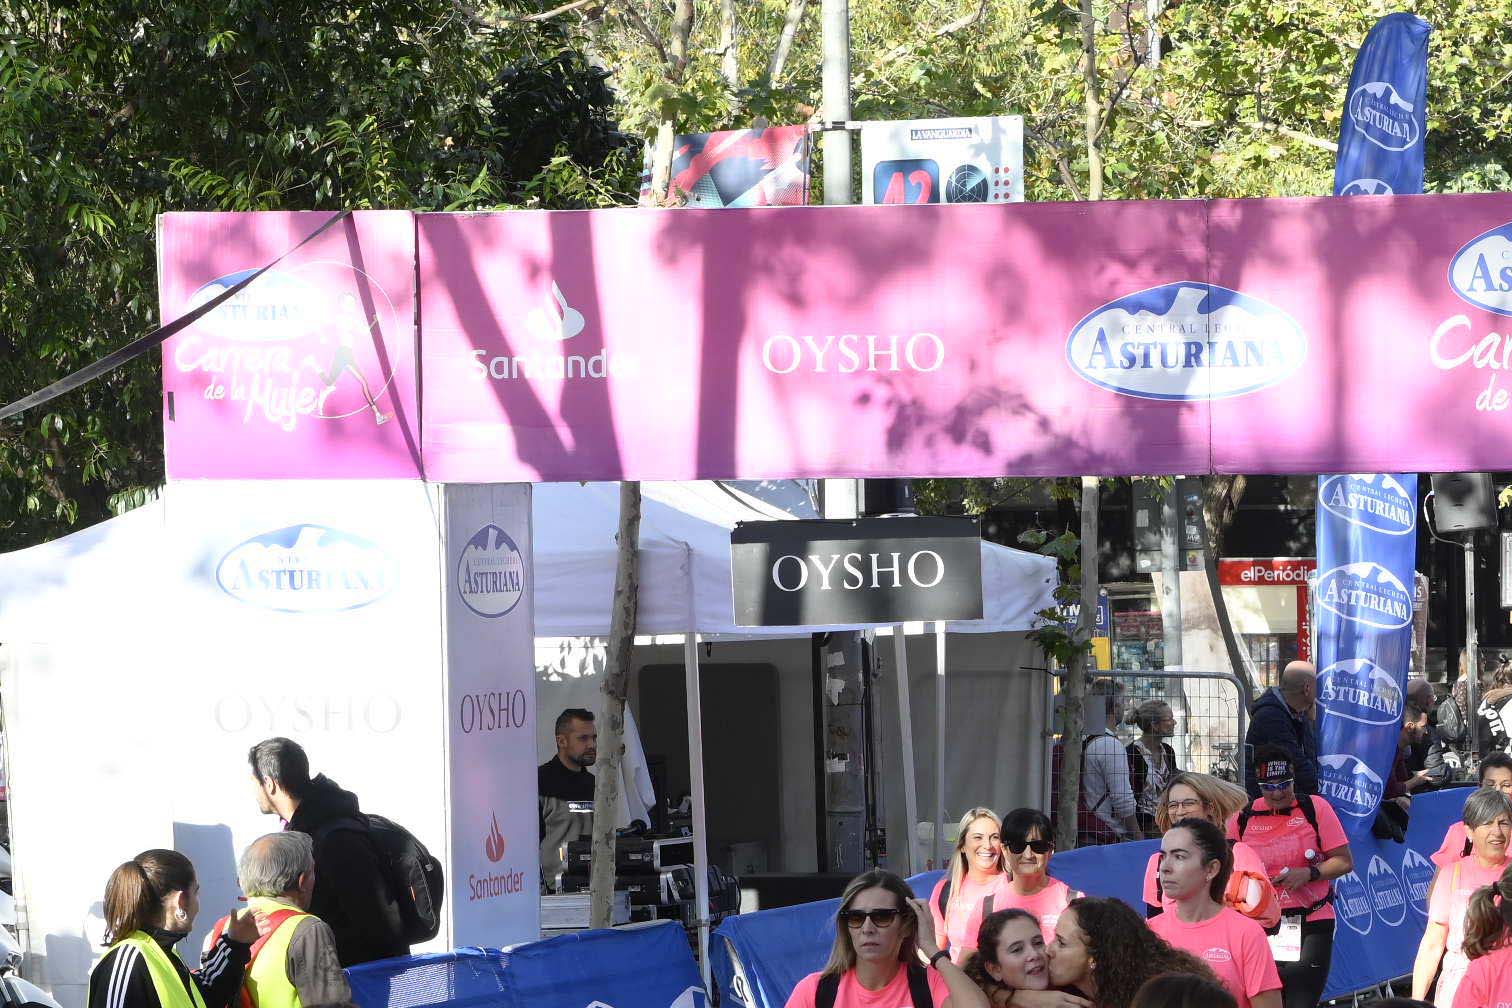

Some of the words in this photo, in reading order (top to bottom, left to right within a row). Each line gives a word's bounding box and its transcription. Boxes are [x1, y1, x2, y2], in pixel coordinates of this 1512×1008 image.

[1122, 321, 1198, 335] CENTRAL
[762, 332, 945, 374] OYSHO
[1086, 327, 1287, 371] ASTURIANA
[203, 377, 225, 400] de
[1476, 373, 1512, 411] de
[1329, 483, 1411, 527] ASTURIANA
[463, 558, 521, 596] ASTURIANA
[773, 550, 946, 592] OYSHO
[1241, 566, 1311, 583] elPeriódi
[1326, 578, 1407, 621] ASTURIANA
[213, 695, 404, 735] OYSHO
[461, 688, 527, 734] OYSHO
[1320, 676, 1398, 717] ASTURIANA
[1318, 778, 1378, 810] STURIANA
[469, 870, 525, 902] Santander
